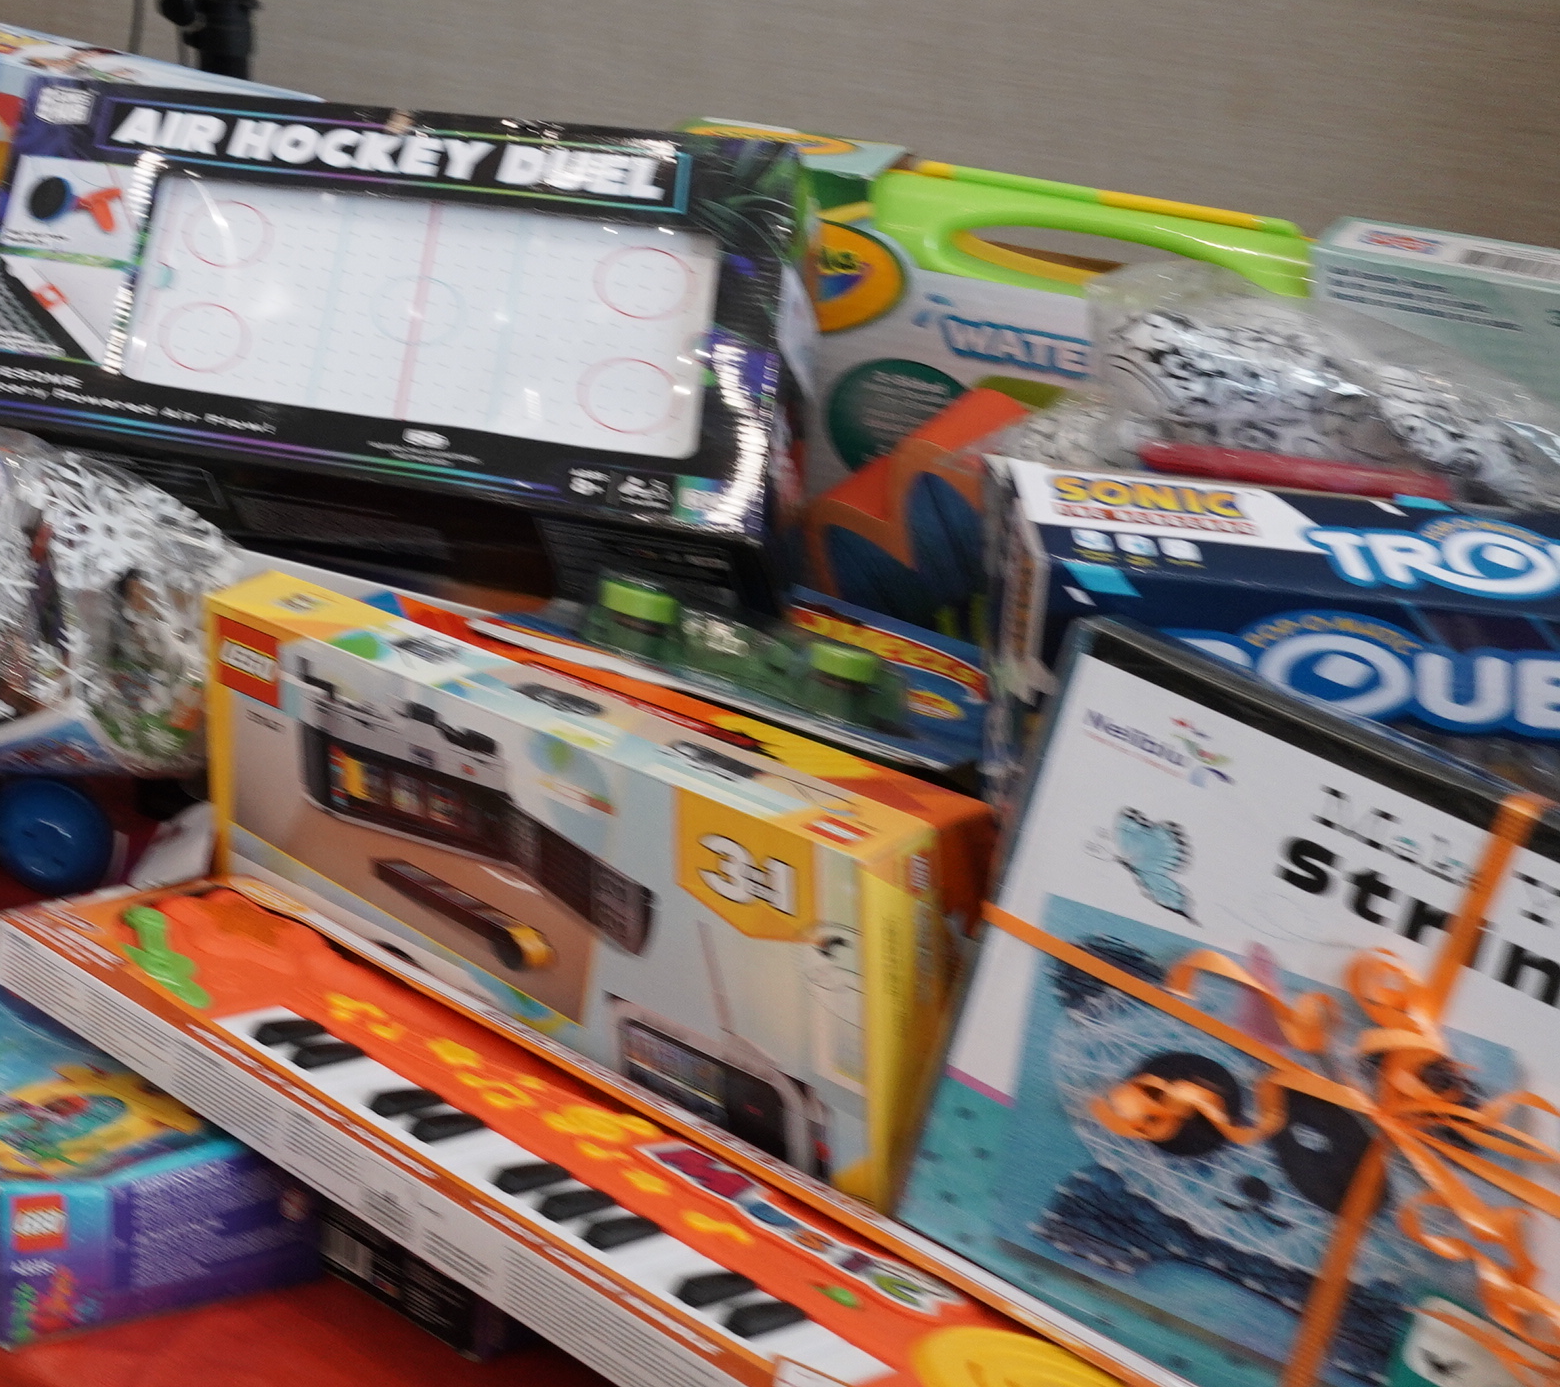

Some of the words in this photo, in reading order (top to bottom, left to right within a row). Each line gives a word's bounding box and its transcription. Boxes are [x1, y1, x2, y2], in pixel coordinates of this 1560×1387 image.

[112, 106, 227, 156] AIR
[227, 119, 496, 184] HOCKEY
[498, 139, 666, 203] DUEL
[946, 319, 1092, 377] WATE
[1052, 474, 1248, 519] SONIC
[221, 637, 278, 685] LEGO
